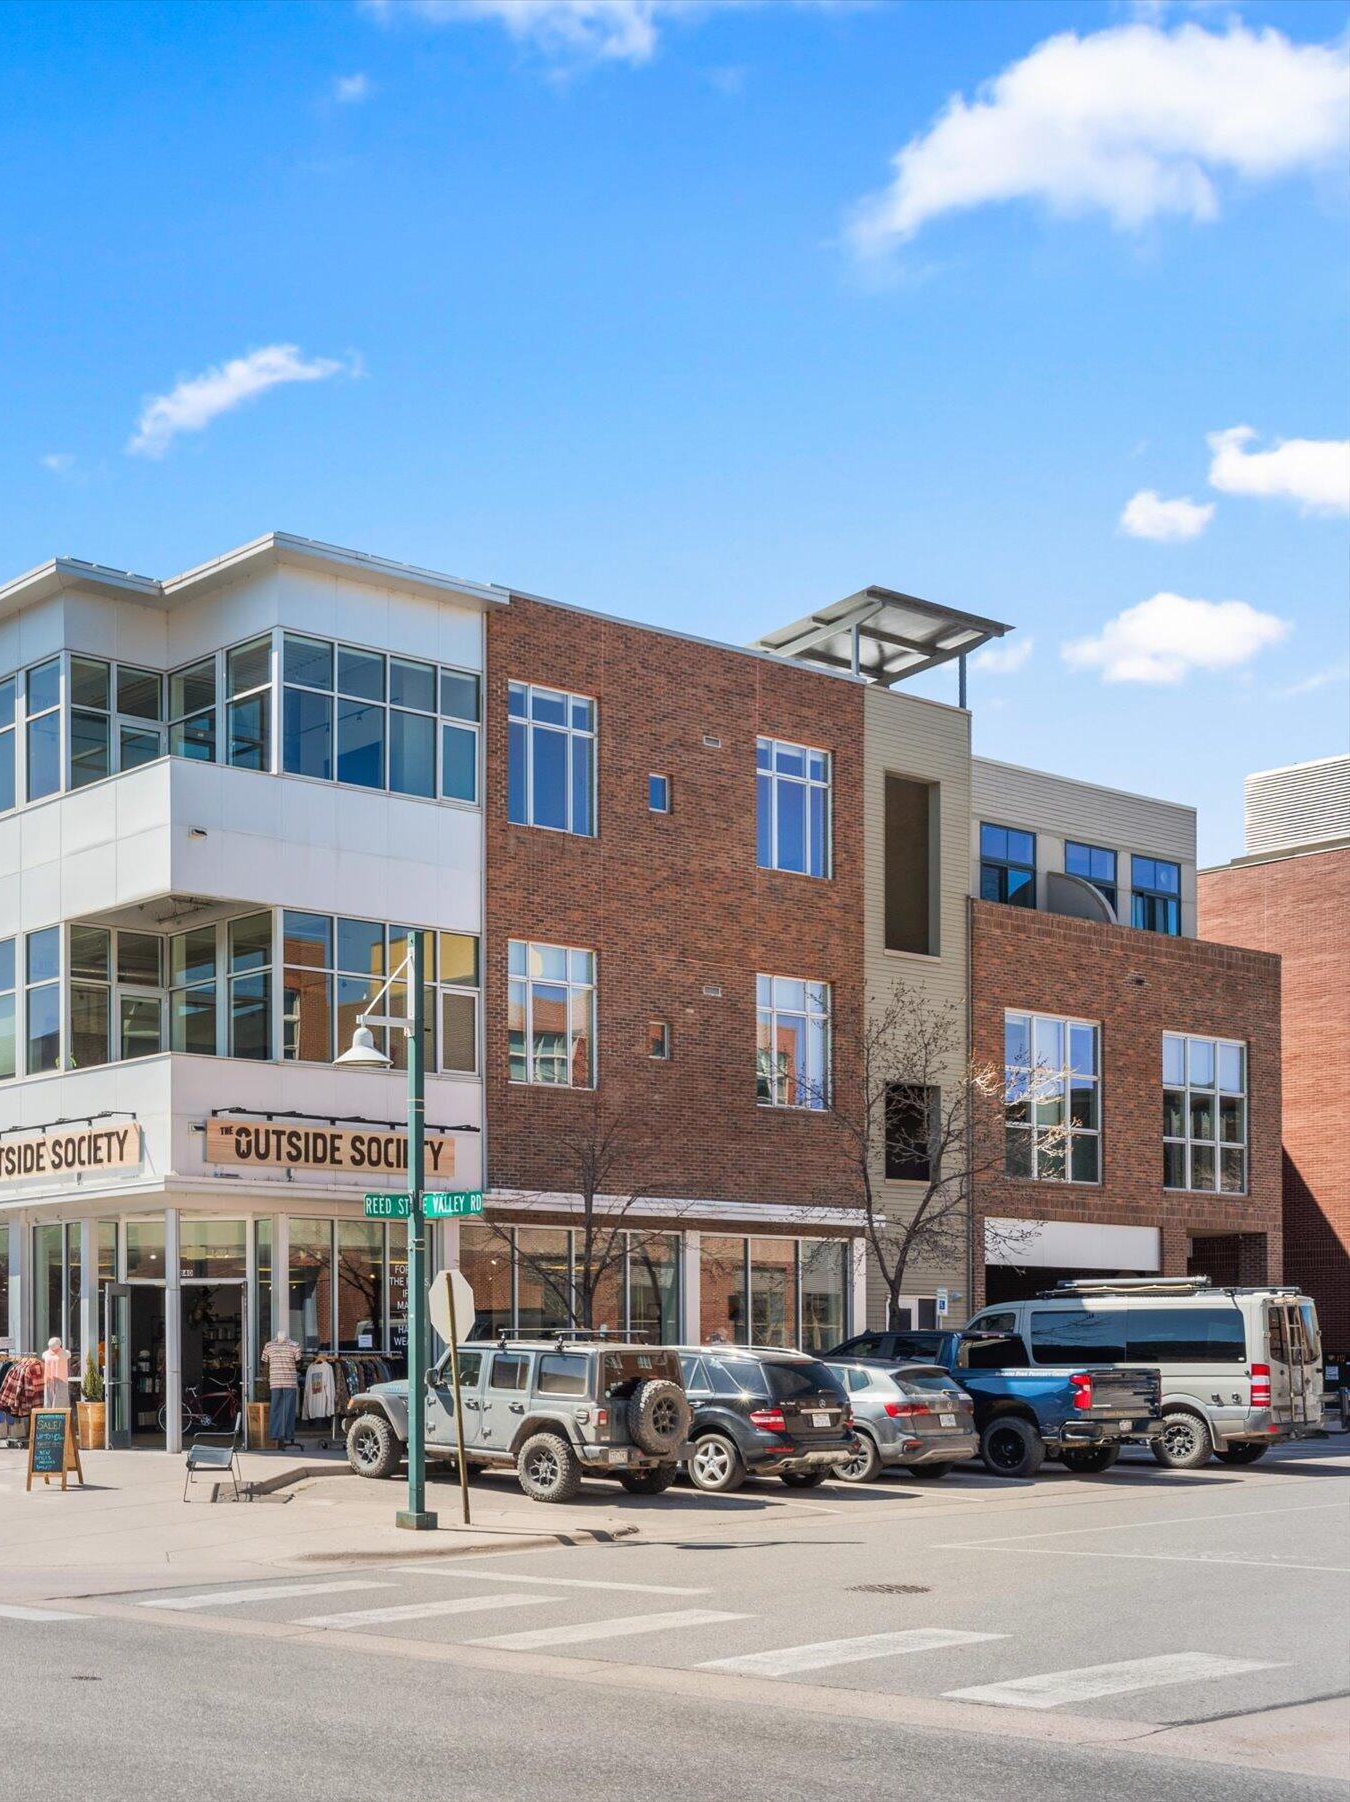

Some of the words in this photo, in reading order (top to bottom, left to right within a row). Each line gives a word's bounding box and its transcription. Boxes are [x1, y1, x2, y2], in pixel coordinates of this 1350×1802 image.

[51, 1130, 128, 1171] SOCIETY
[220, 1126, 233, 1136] THE
[235, 1127, 343, 1165] OUTSIDE
[350, 1135, 444, 1171] SOCIY
[365, 1197, 392, 1214] REED
[398, 1198, 410, 1215] ST
[433, 1195, 465, 1214] VALLEY
[470, 1194, 482, 1212] RD
[389, 1277, 404, 1286] THE
